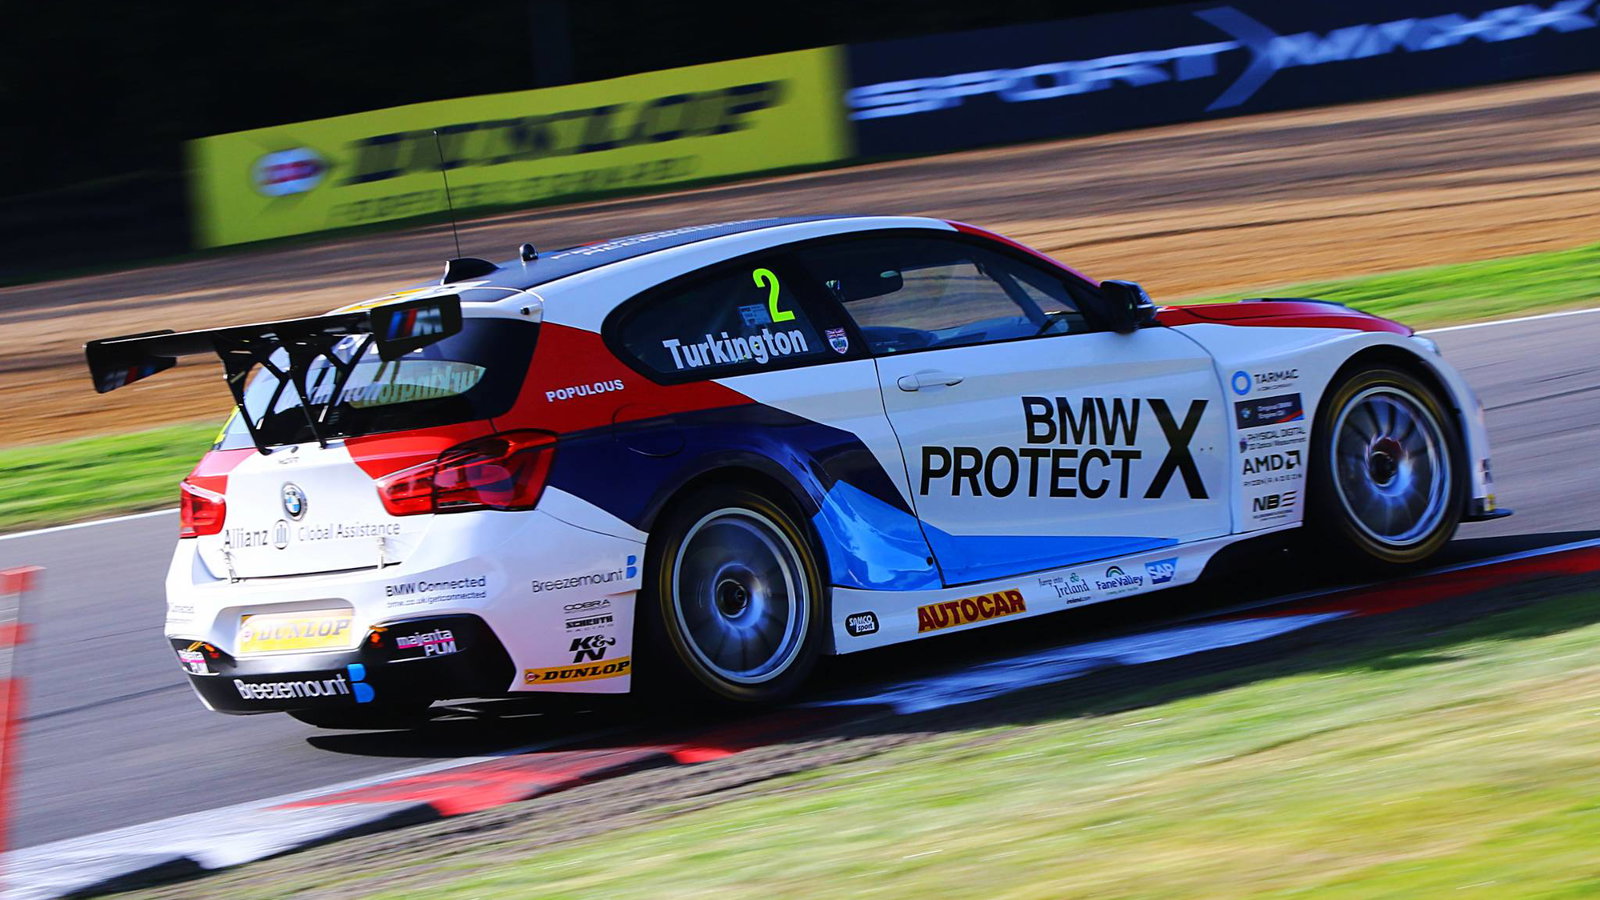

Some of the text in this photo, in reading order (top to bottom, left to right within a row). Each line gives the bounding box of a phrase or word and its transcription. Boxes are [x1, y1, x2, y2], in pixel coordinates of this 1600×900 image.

[752, 268, 796, 322] 2
[662, 328, 809, 370] Turkington
[1254, 369, 1299, 384] TARMAC
[545, 379, 625, 403] POPULOUS
[1022, 396, 1140, 446] BMW
[919, 398, 1210, 499] PROTECT X
[1243, 453, 1284, 475] AMD
[224, 522, 401, 549] Allianz Global Assistance
[532, 568, 623, 593] Breezemount
[1148, 563, 1174, 580] SAP
[386, 575, 486, 597] BMW Connected
[1054, 579, 1090, 598] Ireland
[563, 599, 611, 611] COBRA
[918, 590, 1026, 633] AUTOCAR
[257, 619, 350, 641] DUNLOP
[849, 615, 873, 627] SAMCO
[396, 629, 452, 647] majenta
[425, 641, 457, 657] PLM
[569, 634, 616, 664] K&N
[542, 661, 630, 681] DUNLOP
[233, 676, 350, 699] Breezemount
